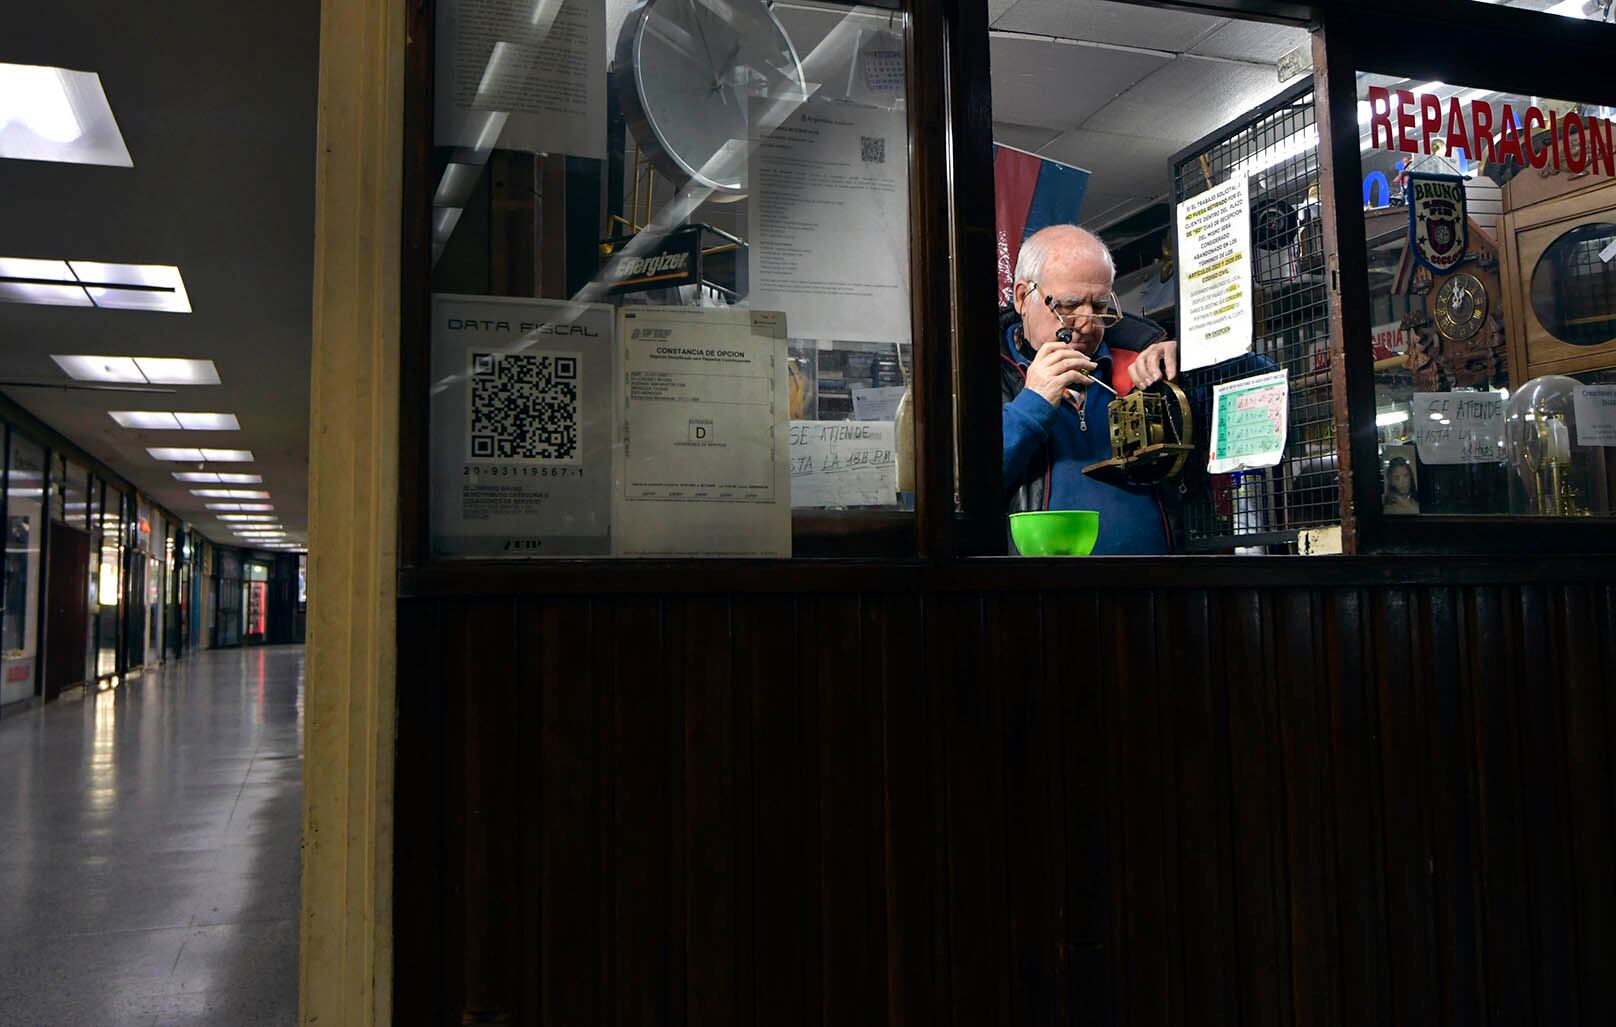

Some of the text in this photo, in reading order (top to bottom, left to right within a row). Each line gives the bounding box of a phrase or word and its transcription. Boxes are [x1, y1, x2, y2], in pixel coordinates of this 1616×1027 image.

[1369, 86, 1615, 177] REPARACION
[1197, 194, 1217, 207] TRABAJO
[1414, 183, 1460, 202] BRUNO
[1185, 219, 1202, 230] CLIENTE
[1203, 210, 1220, 222] DENTRO
[615, 251, 688, 277] Energizer
[448, 319, 511, 332] DATA
[656, 347, 745, 358] CONSTANCIA DE OPCION
[696, 426, 706, 439] D
[790, 426, 810, 446] SE
[463, 466, 584, 478] 20-93119567-1
